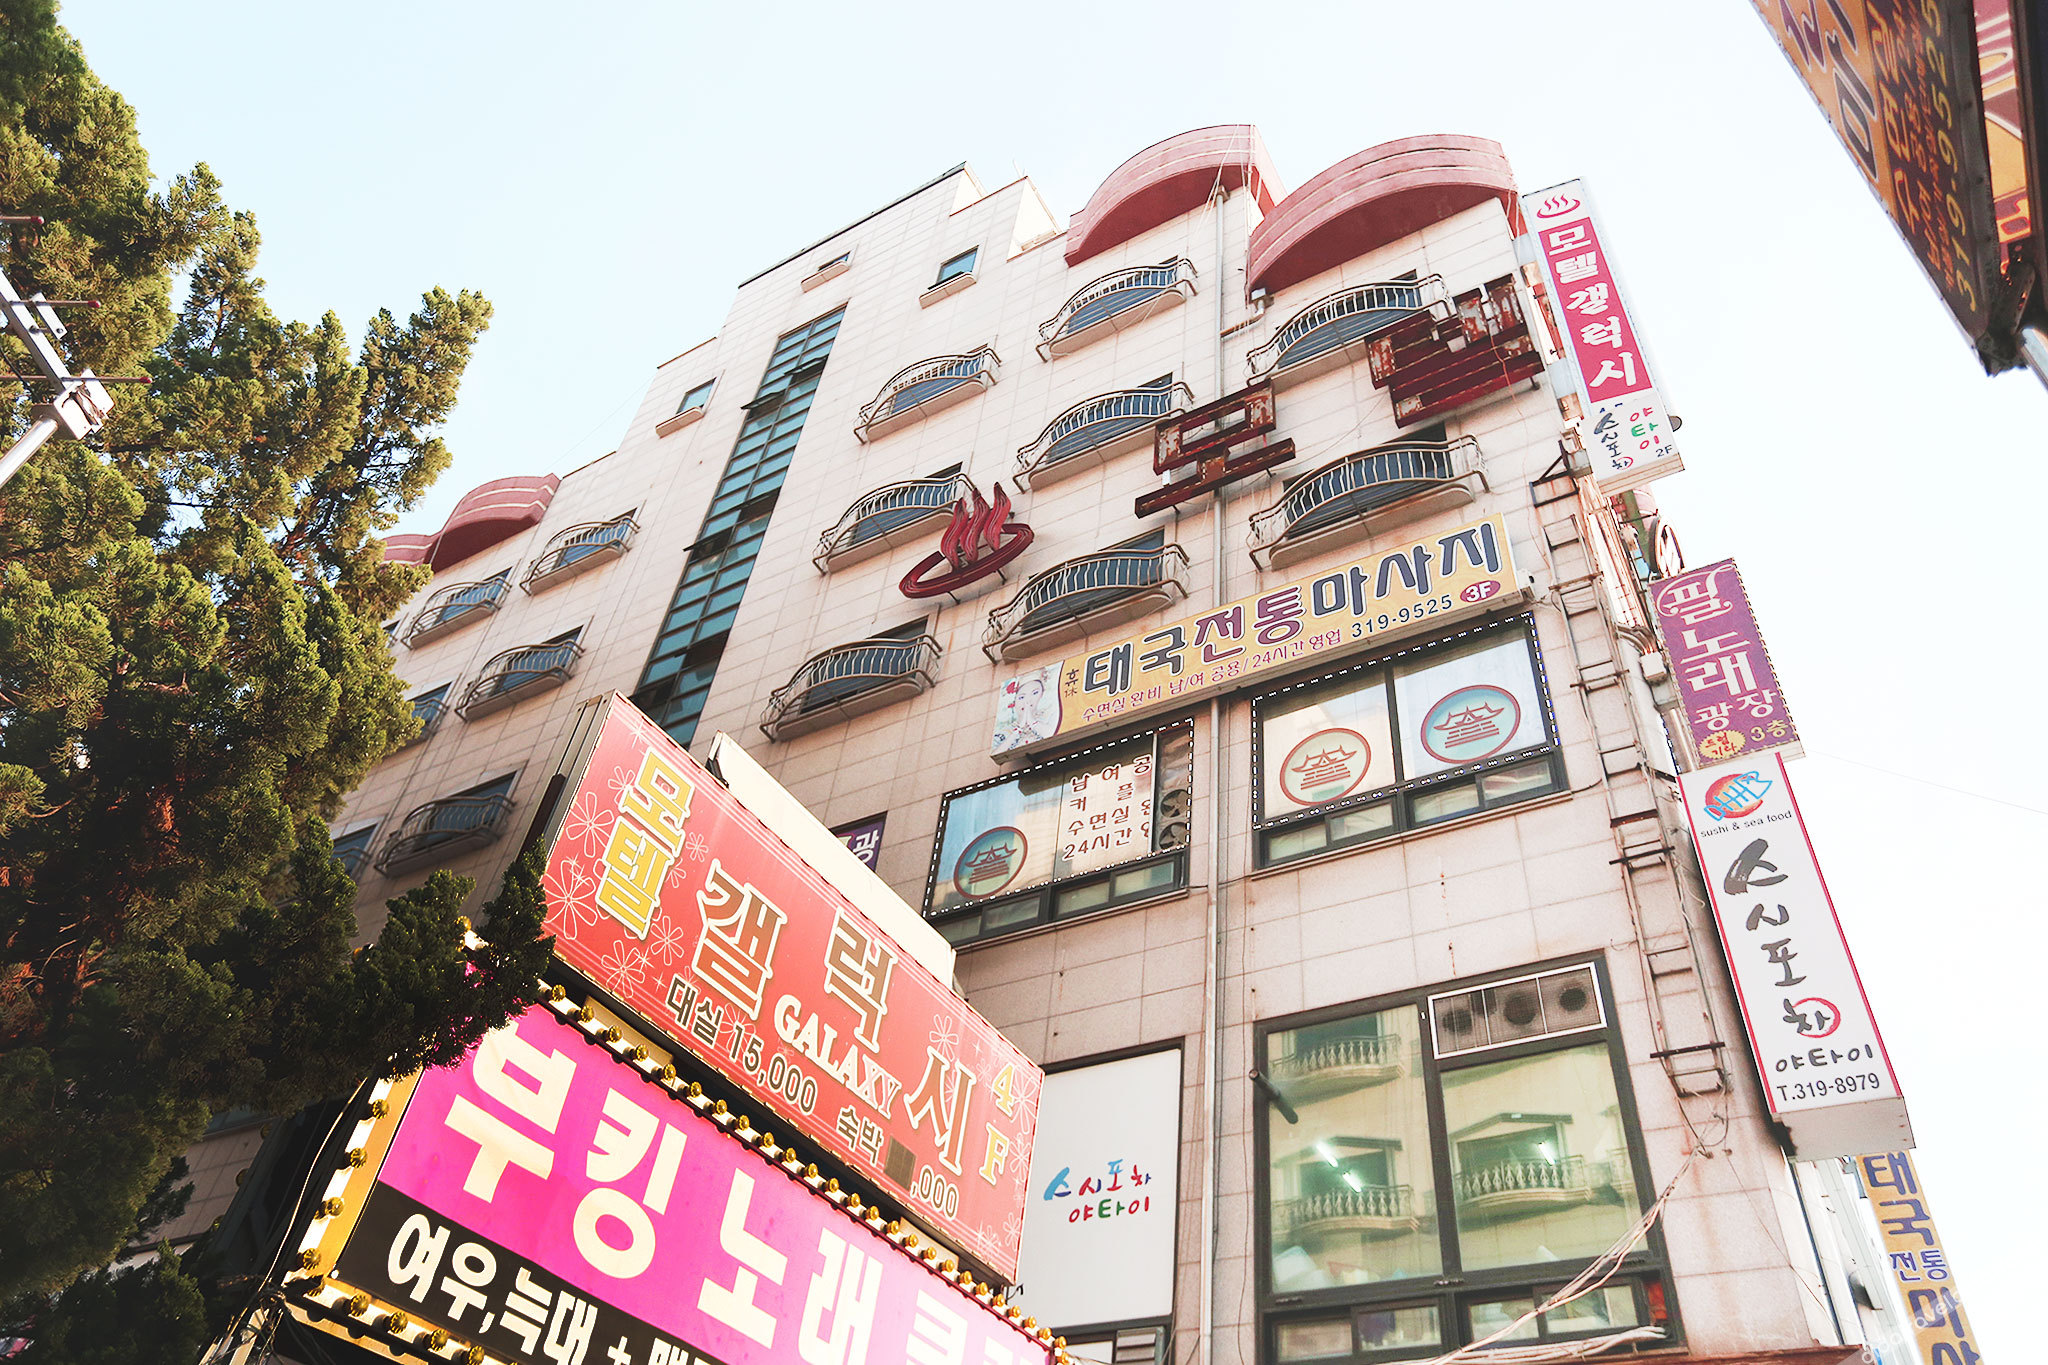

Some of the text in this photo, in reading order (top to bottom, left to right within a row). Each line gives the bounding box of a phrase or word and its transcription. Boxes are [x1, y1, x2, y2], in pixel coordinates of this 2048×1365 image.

[1655, 445, 1673, 458] 2F
[1083, 697, 1126, 722] 수면실
[1309, 628, 1342, 650] 영업
[1466, 581, 1493, 602] 3F
[1750, 720, 1789, 742] 3층
[1068, 806, 1130, 836] 수면실
[1700, 810, 1792, 838] sushi & sea food
[1064, 828, 1132, 860] 24시간
[667, 975, 725, 1044] 대실
[728, 1021, 818, 1115] 15,000
[836, 1104, 884, 1167] 숙박
[774, 994, 903, 1120] GALAXY
[1775, 1044, 1875, 1073] 야타이
[1776, 1073, 1881, 1102] T.319-8979
[444, 1020, 688, 1279] 부킹
[1068, 1196, 1150, 1223] 야타이
